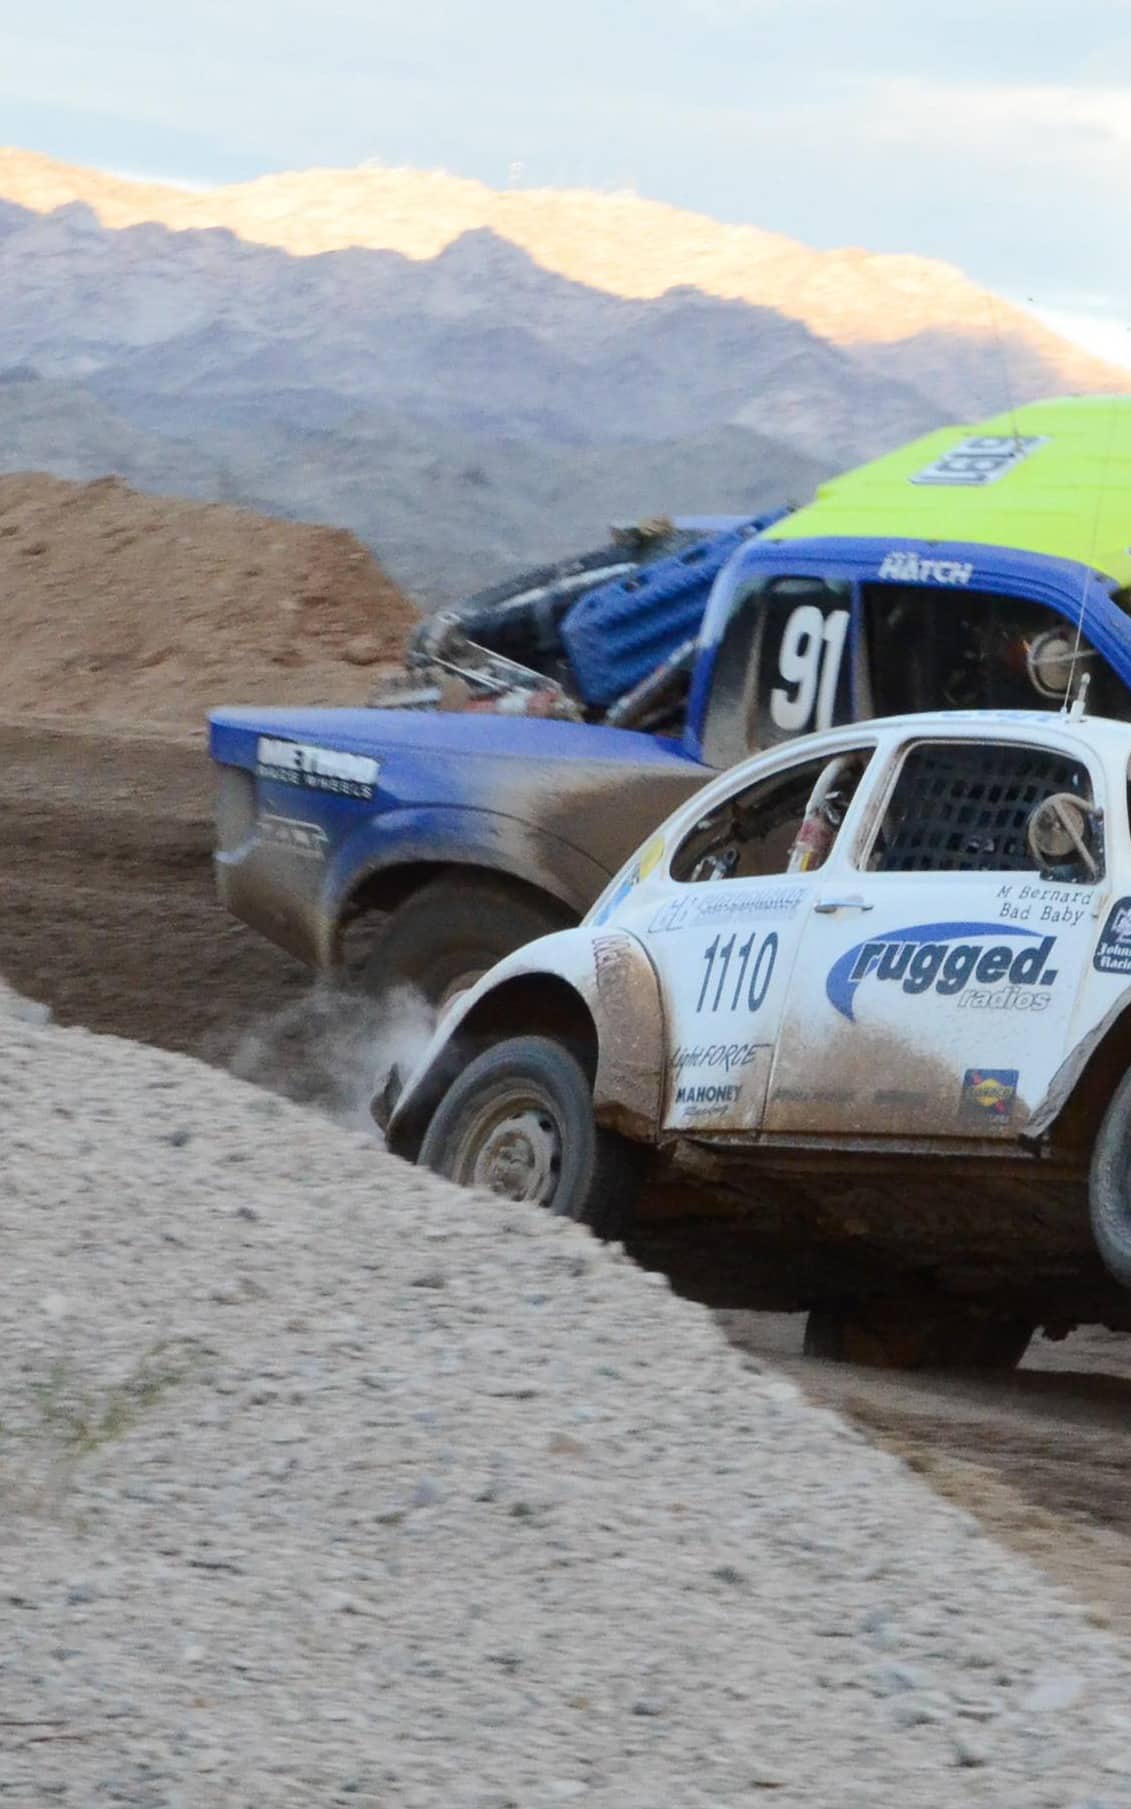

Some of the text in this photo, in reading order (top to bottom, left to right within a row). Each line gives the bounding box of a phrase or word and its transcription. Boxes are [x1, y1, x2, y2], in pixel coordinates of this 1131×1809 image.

[770, 605, 850, 731] 91
[995, 886, 1095, 905] M Bernard
[999, 902, 1085, 927] Bad Baby
[696, 931, 779, 1013] 1110
[958, 985, 1052, 1011] radios
[676, 1084, 742, 1103] MAHONEY
